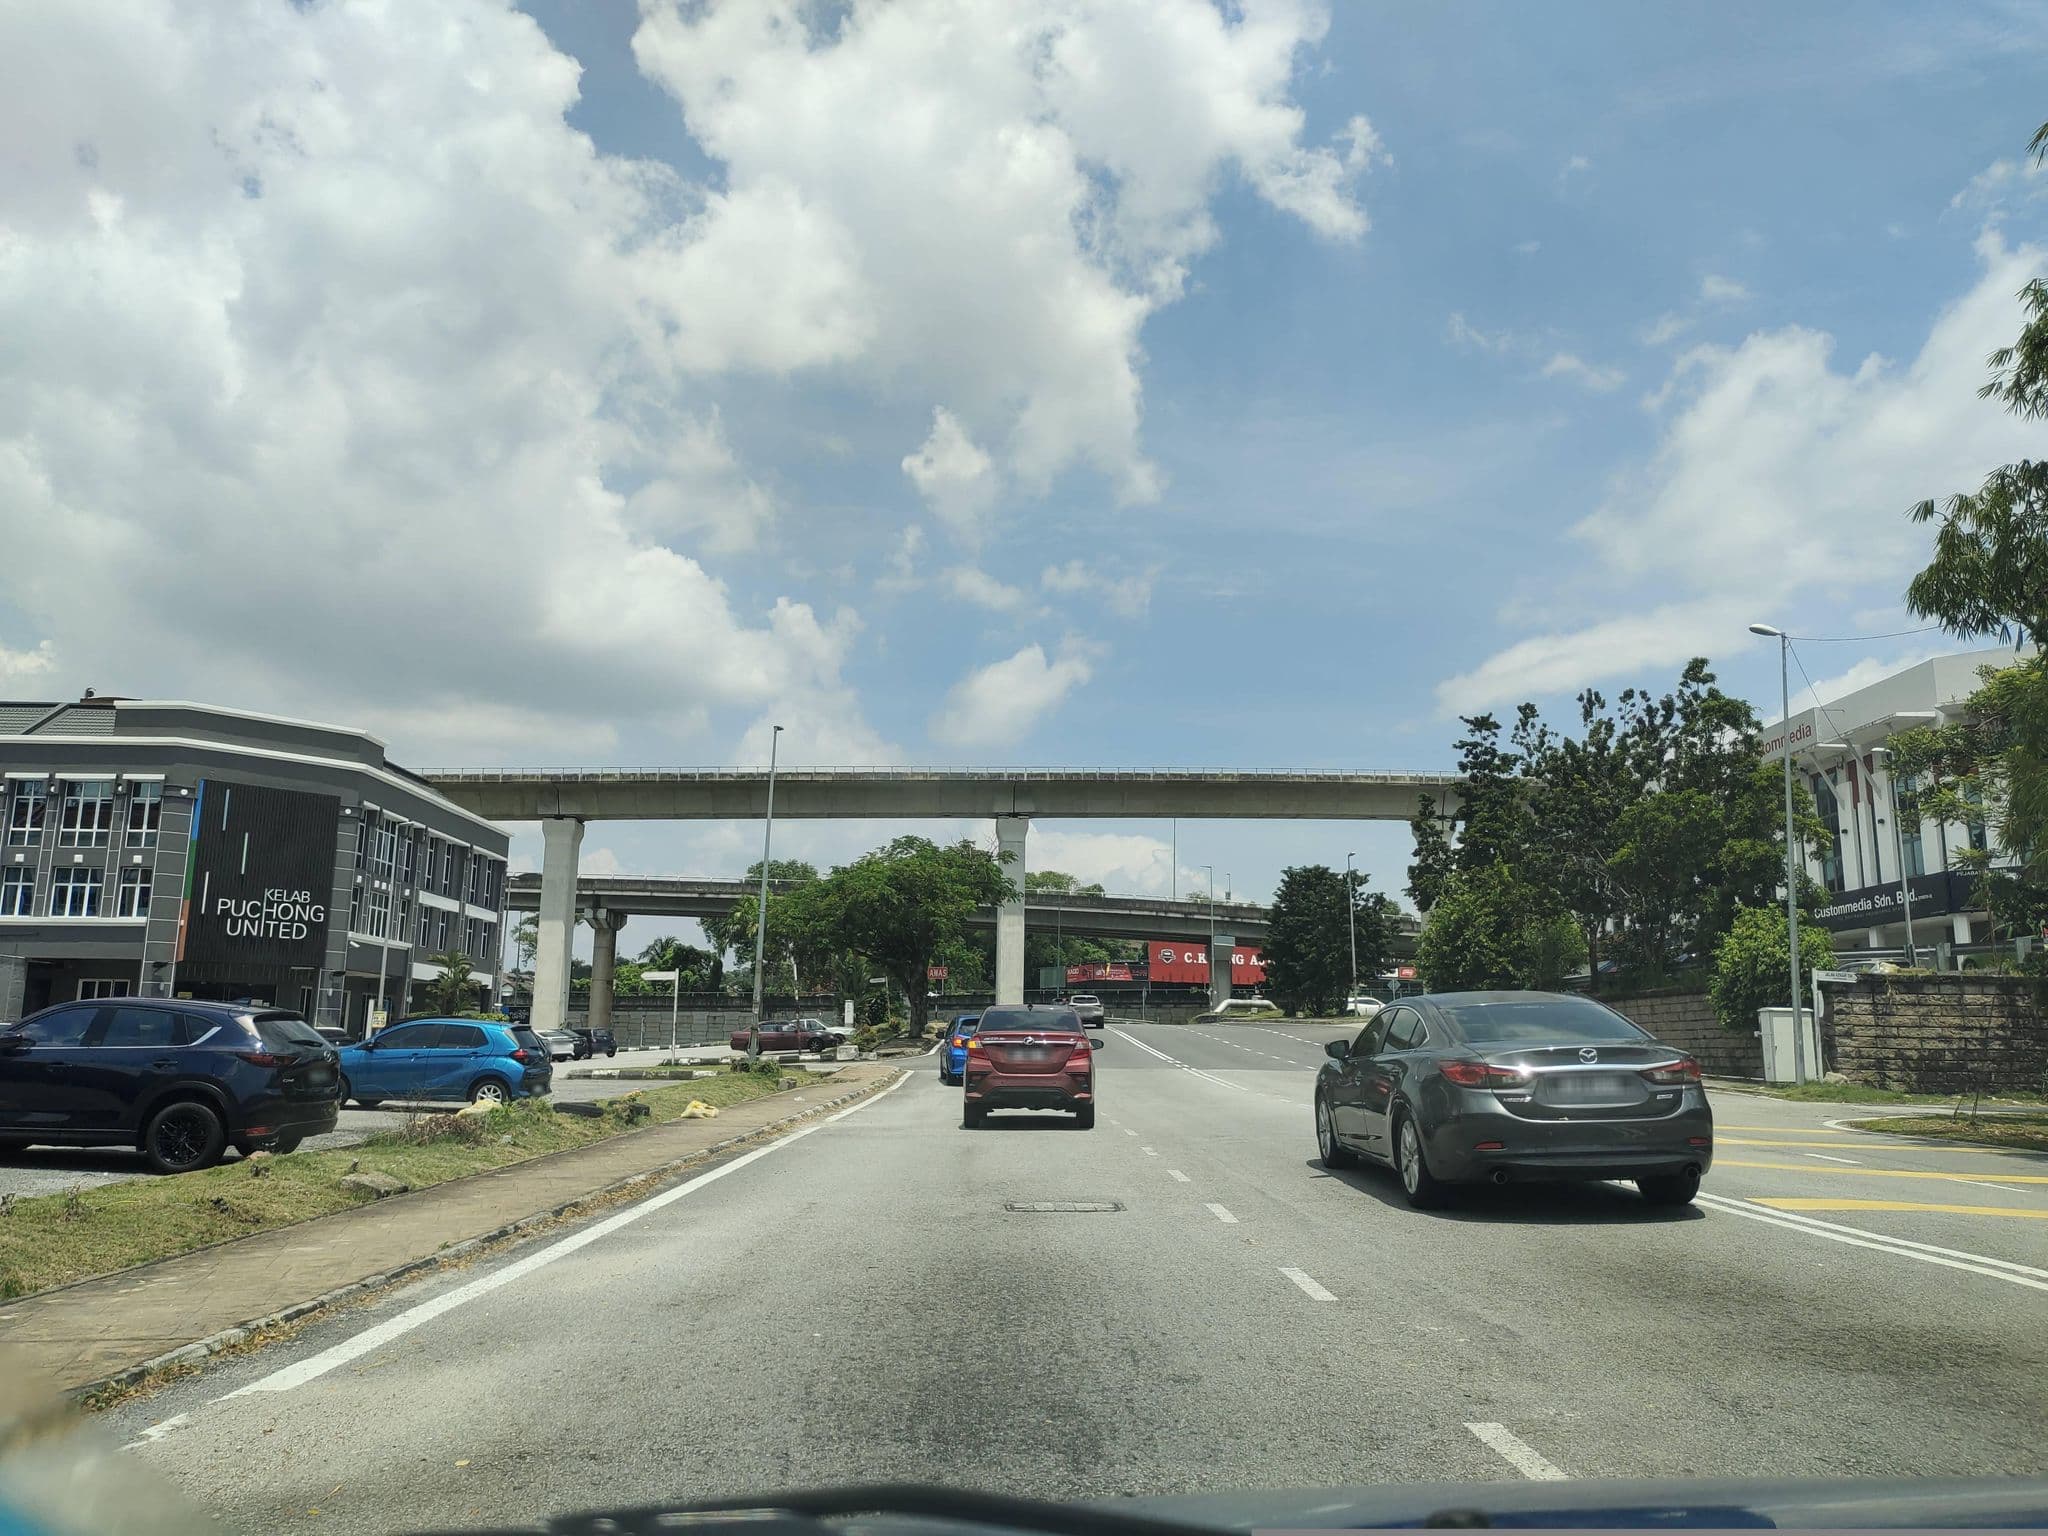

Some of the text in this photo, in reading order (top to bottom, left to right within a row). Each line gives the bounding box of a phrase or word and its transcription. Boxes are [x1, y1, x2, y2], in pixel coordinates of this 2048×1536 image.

[1762, 724, 1812, 754] ommedia
[264, 888, 311, 904] KELAB
[1814, 898, 1872, 919] Custommedia
[1874, 893, 1894, 908] Sdn.
[1896, 888, 1918, 904] Bd.
[217, 898, 325, 922] PUCHONG
[226, 918, 307, 940] UNITED
[929, 969, 948, 977] AWAS
